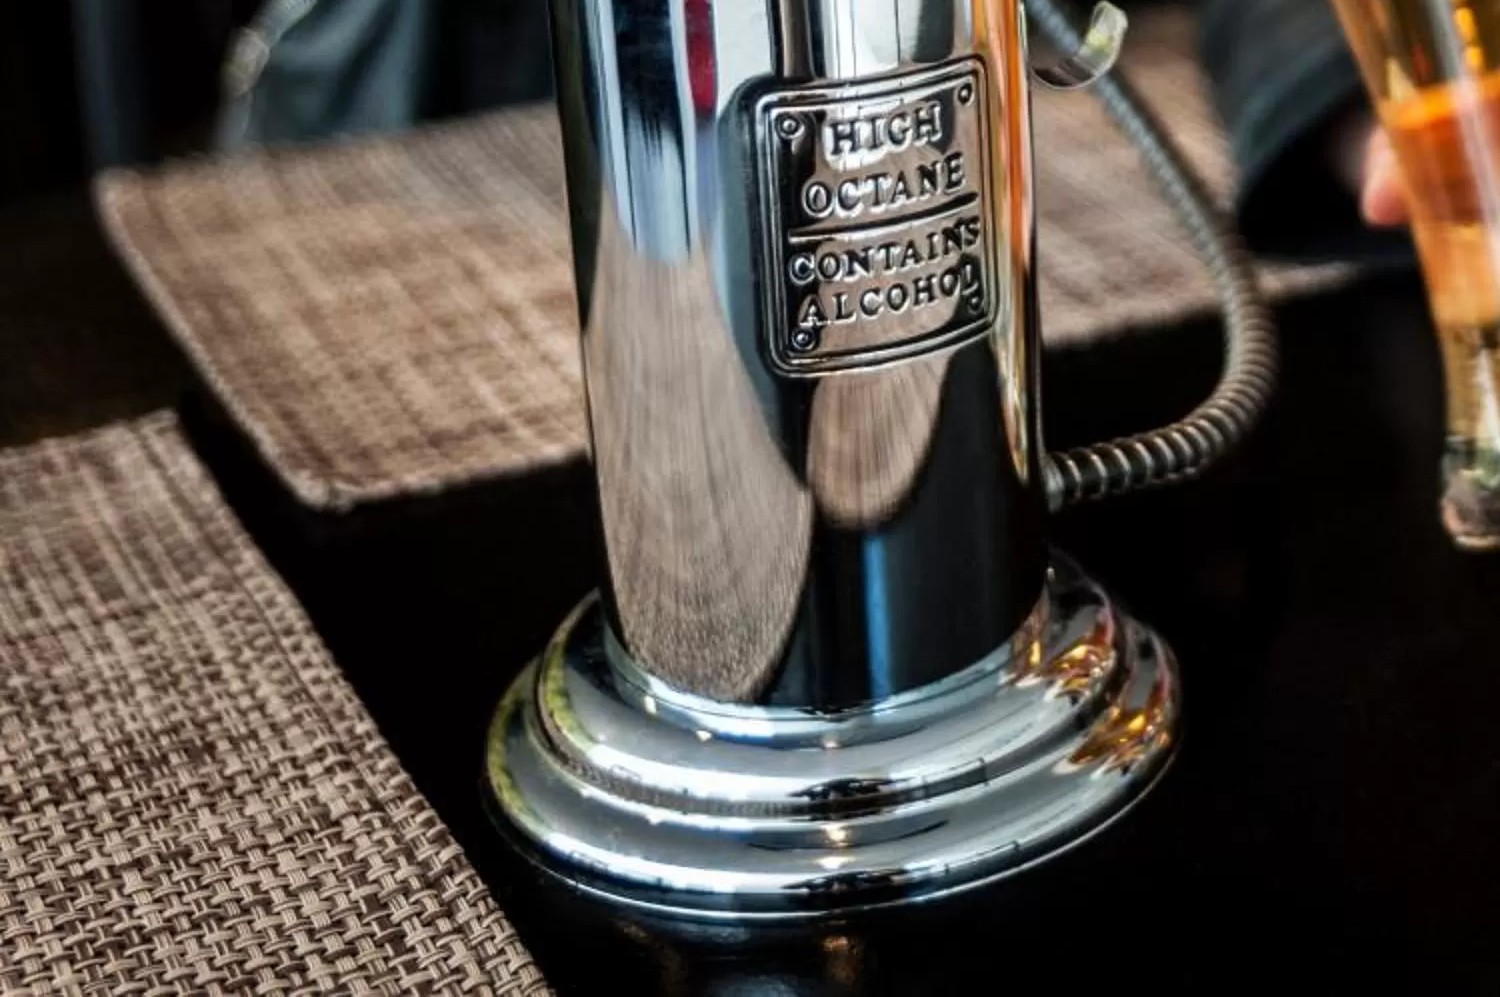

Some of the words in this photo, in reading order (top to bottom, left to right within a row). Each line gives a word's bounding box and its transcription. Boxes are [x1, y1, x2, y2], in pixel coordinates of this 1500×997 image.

[829, 101, 942, 156] HIGH
[804, 152, 966, 216] OCTANE
[789, 215, 980, 283] CONTAINS
[799, 262, 980, 326] ALCOHOL
